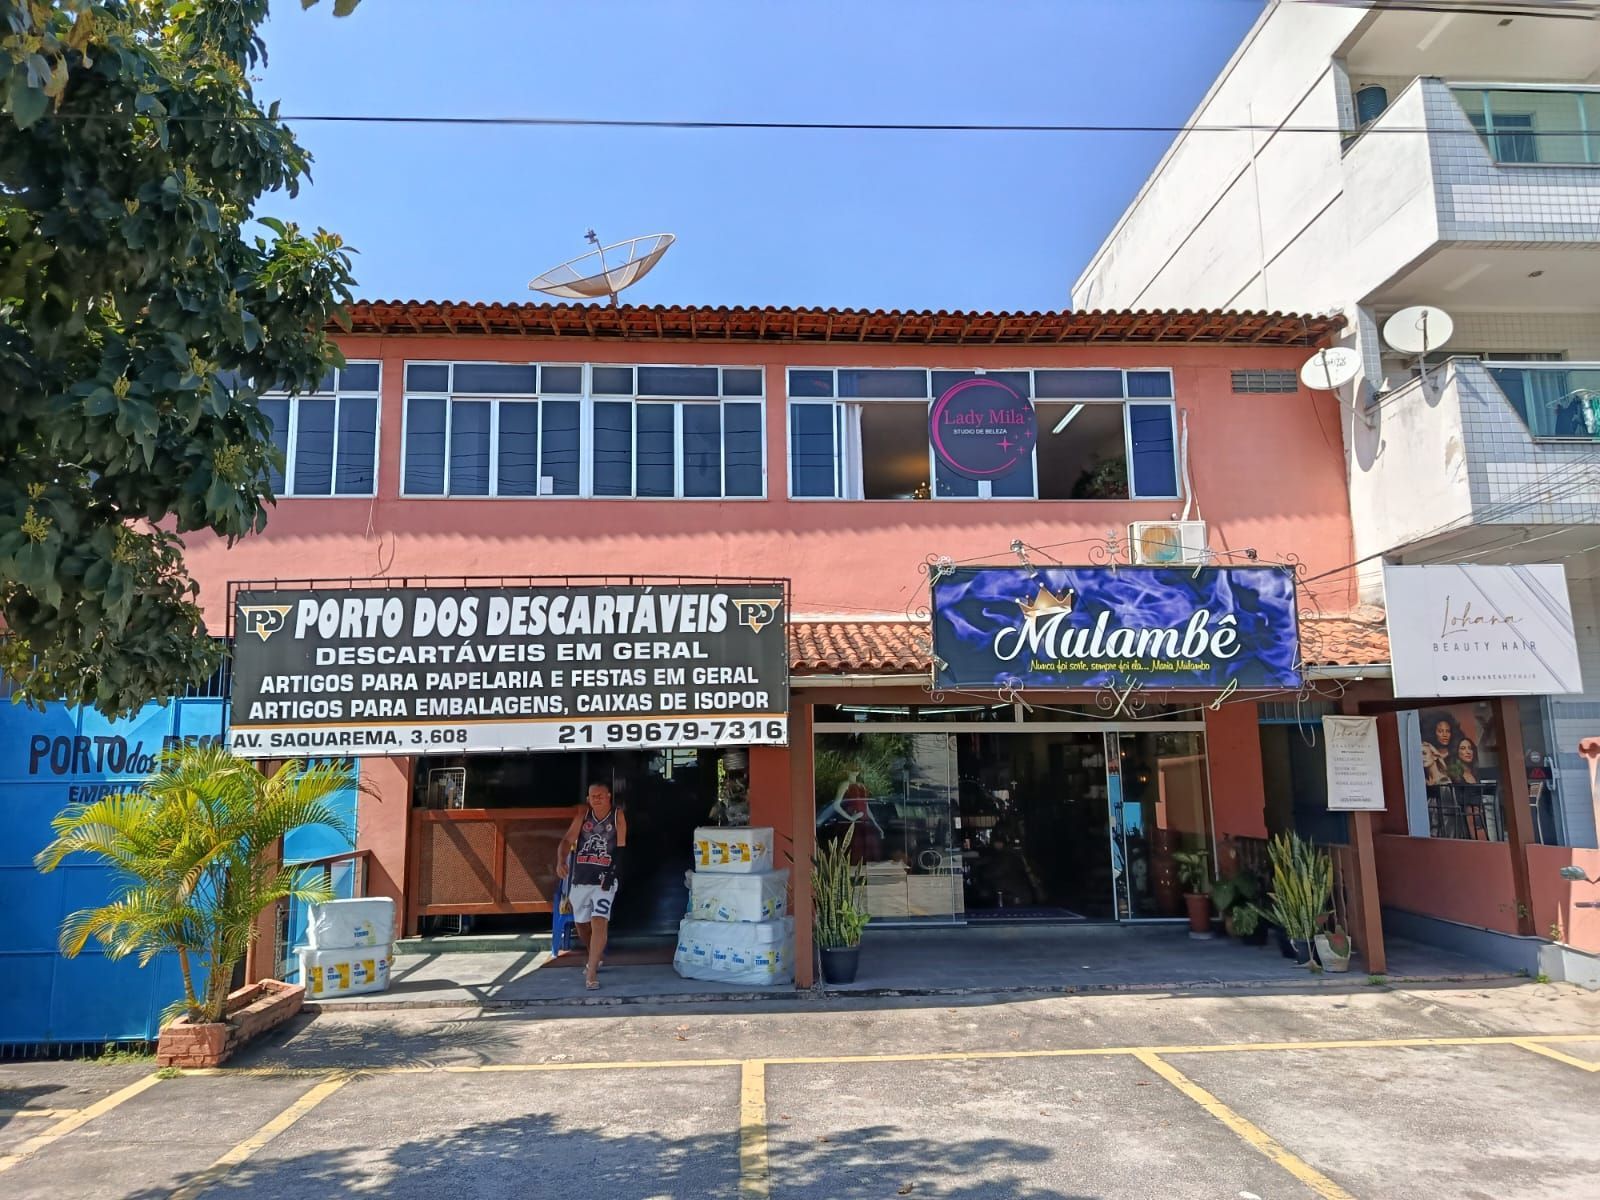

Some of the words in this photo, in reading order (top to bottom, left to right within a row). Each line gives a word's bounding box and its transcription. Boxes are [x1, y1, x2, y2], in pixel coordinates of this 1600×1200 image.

[944, 409, 984, 428] Lady
[990, 409, 1024, 424] Mila
[294, 597, 404, 639] PORTO
[412, 596, 479, 637] DOS
[486, 586, 728, 636] DESCARTÁVEIS
[1441, 595, 1523, 638] Lohana
[994, 605, 1241, 661] Mulambê
[1433, 642, 1490, 652] BEAUTY
[1502, 640, 1537, 652] HAIR
[315, 640, 546, 666] DESCARTÁVEIS
[557, 643, 602, 662] EM
[613, 641, 708, 660] GERAL
[1029, 660, 1055, 672] Nunca
[1150, 660, 1174, 673] Maria
[1174, 660, 1211, 673] Mulambo
[260, 674, 354, 694] ARTIGOS
[361, 672, 418, 691] PARA
[426, 670, 544, 690] PAPELARIA
[551, 669, 563, 688] E
[571, 668, 647, 687] FESTAS
[654, 667, 685, 686] EM
[692, 666, 759, 685] GERAL
[248, 700, 343, 720] ARTIGOS
[350, 698, 408, 718] PARA
[415, 695, 569, 716] EMBALAGENS,
[576, 693, 653, 712] CAIXAS
[659, 692, 687, 710] DE
[694, 691, 769, 709] ISOPOR
[233, 733, 263, 748] AV.
[270, 730, 403, 747] SAQUAREMA,
[410, 729, 468, 744] 3.608
[558, 725, 593, 743] 21
[606, 720, 783, 742] 99679-7316
[29, 735, 128, 775] PORTO
